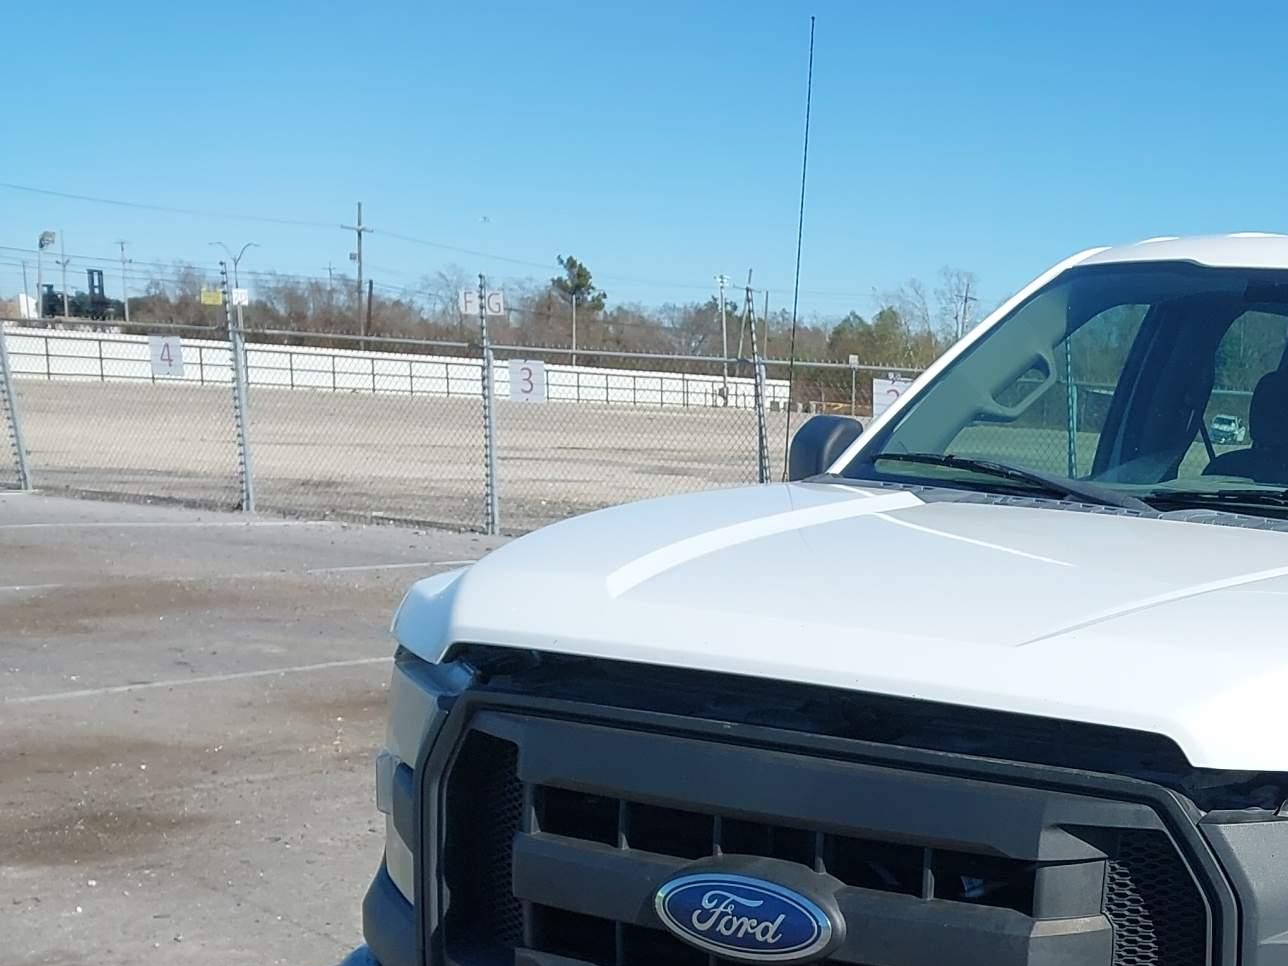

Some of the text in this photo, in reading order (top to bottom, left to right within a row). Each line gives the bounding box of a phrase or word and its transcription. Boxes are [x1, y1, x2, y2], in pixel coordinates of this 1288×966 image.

[463, 291, 473, 312] F
[487, 292, 501, 314] G
[160, 342, 174, 367] 4
[520, 367, 534, 394] 3
[691, 890, 787, 944] Ford
